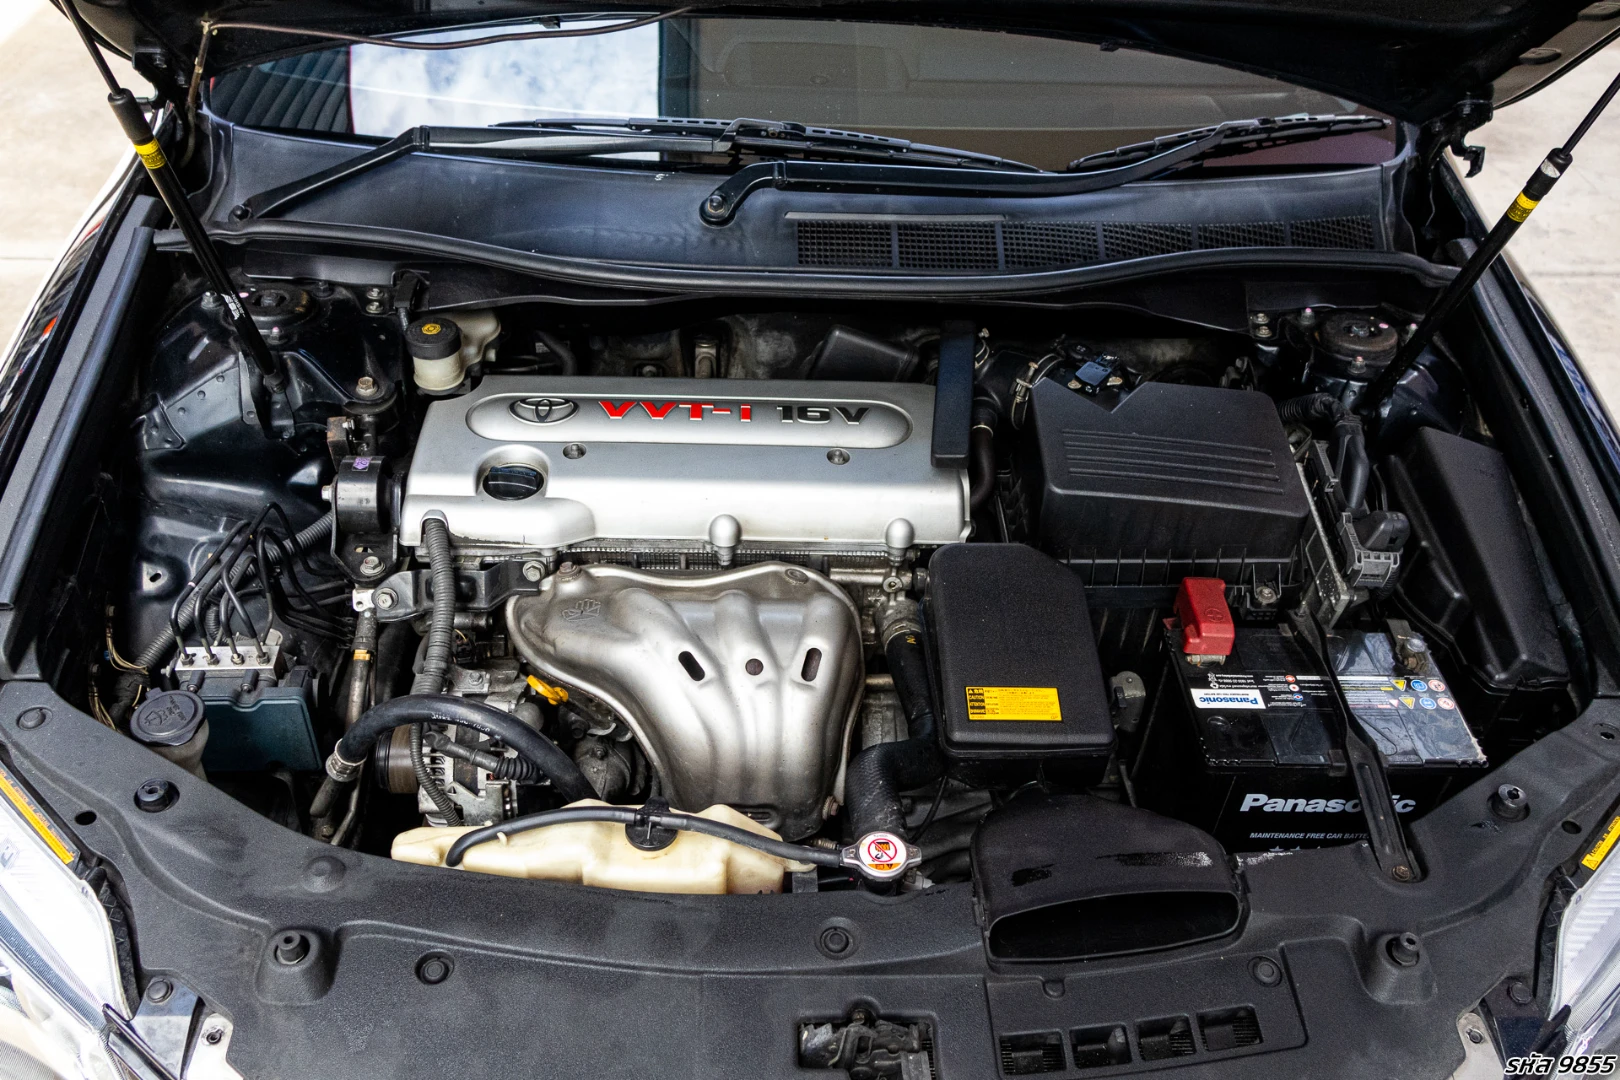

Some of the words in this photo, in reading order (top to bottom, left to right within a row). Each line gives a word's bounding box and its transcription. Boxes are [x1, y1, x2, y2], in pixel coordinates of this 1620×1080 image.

[776, 405, 870, 425] 16V
[1199, 696, 1259, 704] Panasonic
[1240, 793, 1416, 813] Panasoic
